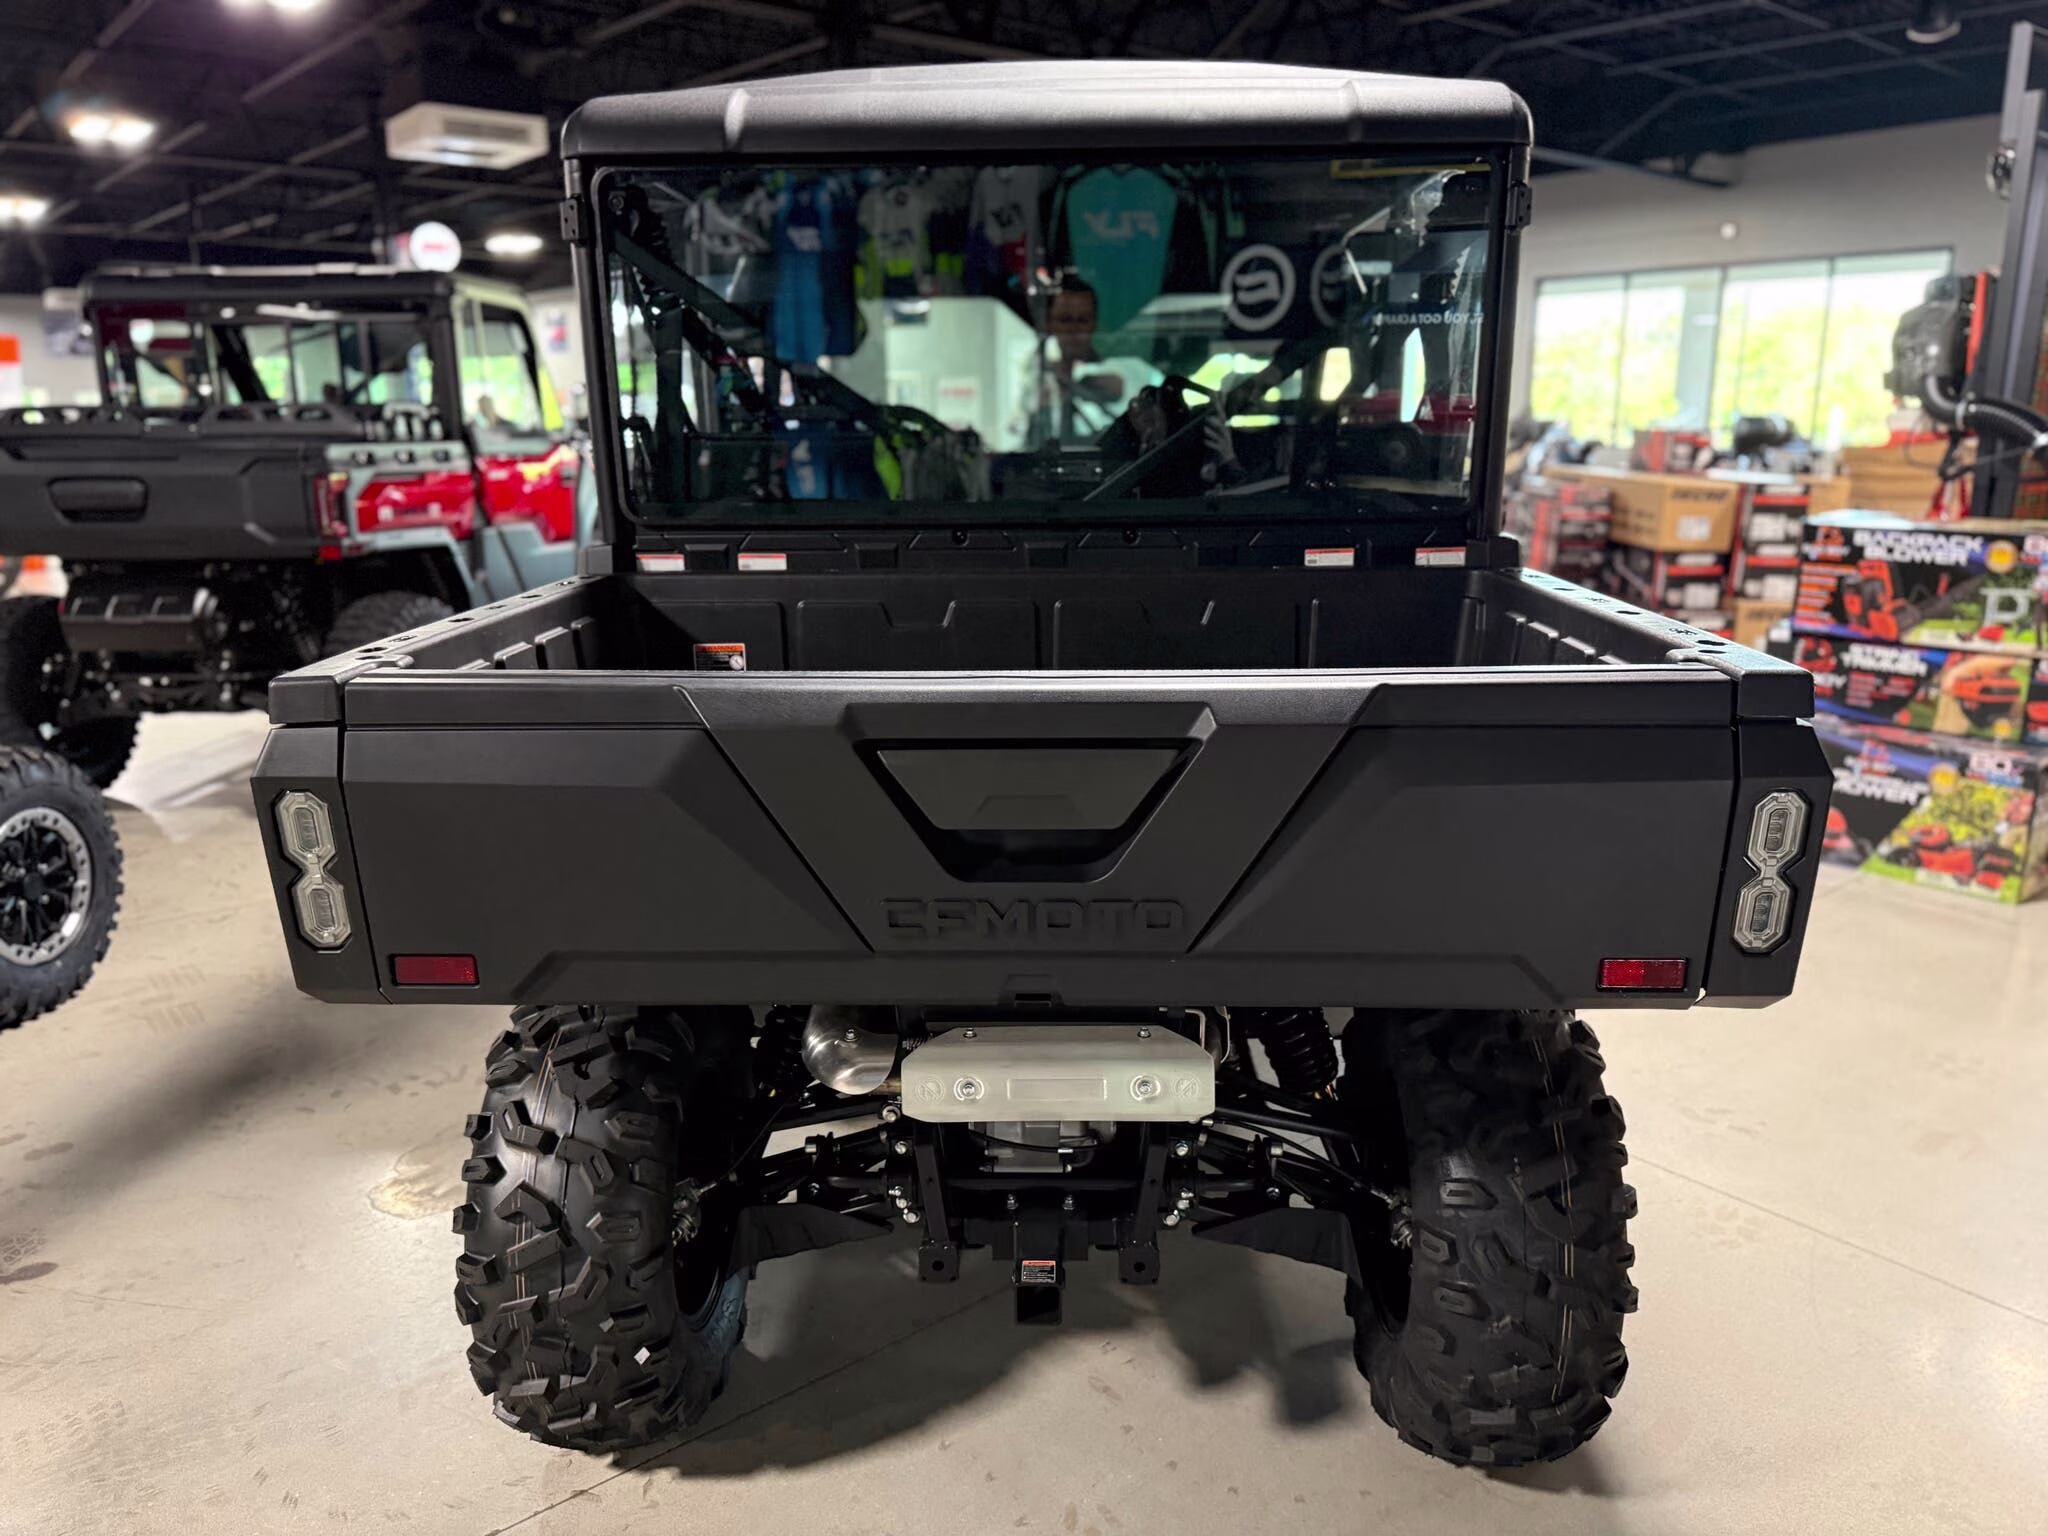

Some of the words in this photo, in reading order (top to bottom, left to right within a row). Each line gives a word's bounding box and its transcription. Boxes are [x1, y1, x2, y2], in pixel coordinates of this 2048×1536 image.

[1853, 529, 1984, 554] BACKPACK
[1863, 545, 1968, 566] BLOWER
[881, 898, 1186, 939] CFMOTO
